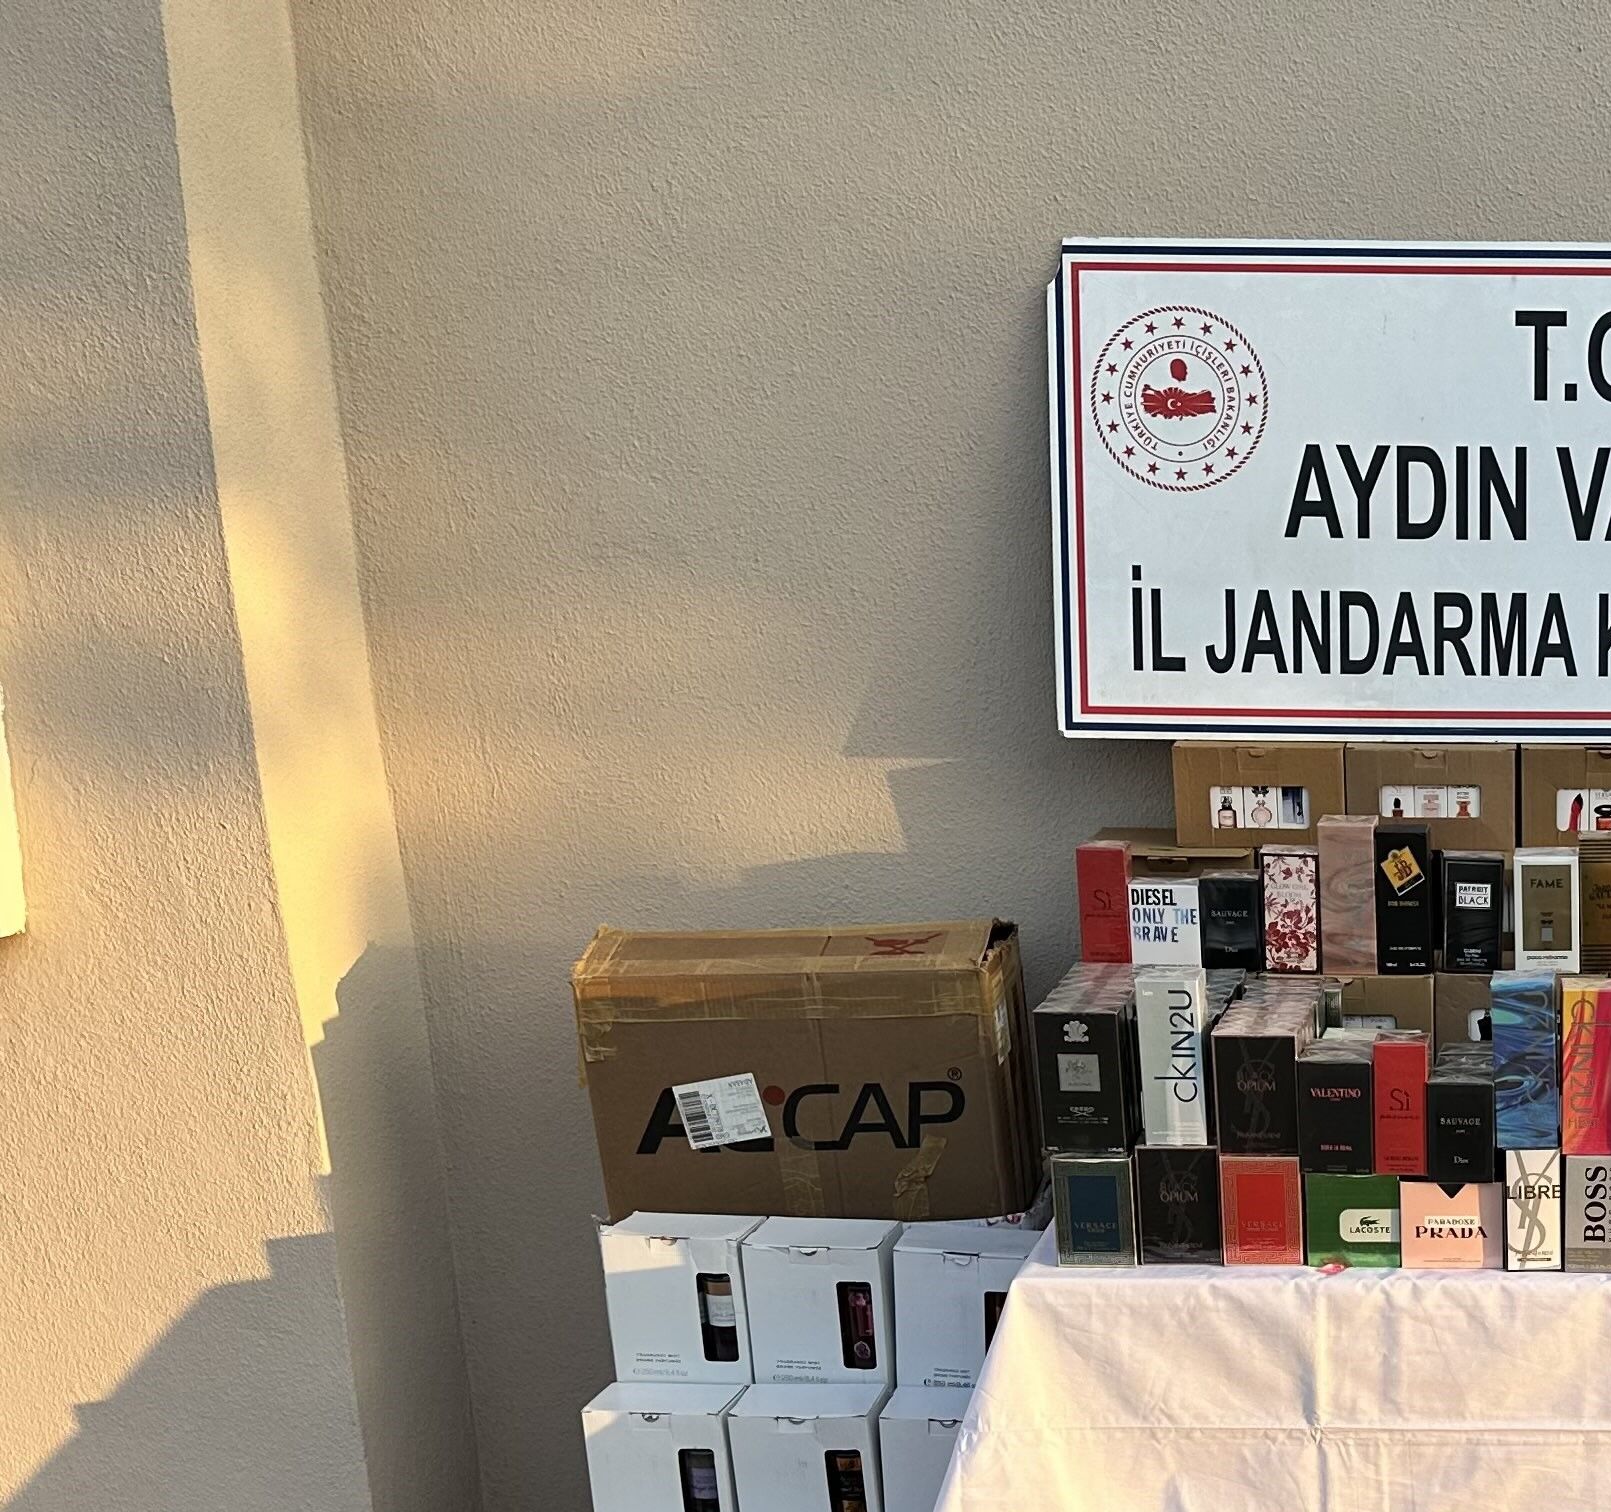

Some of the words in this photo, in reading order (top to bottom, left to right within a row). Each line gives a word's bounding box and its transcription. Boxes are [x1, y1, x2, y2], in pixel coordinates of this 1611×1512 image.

[1285, 444, 1528, 541] AYDIN
[1131, 565, 1186, 673] İL
[1206, 591, 1578, 680] JANDARMA
[1530, 878, 1564, 889] FAME
[1131, 888, 1177, 906] DIESEL
[1458, 895, 1490, 906] BLACK
[1132, 908, 1164, 925] ONLY
[1174, 908, 1198, 925] THE
[1210, 910, 1249, 918] SAUVAGE
[1133, 926, 1179, 943] BRAVE
[1236, 1080, 1276, 1092] OPIUM
[1309, 1087, 1362, 1099] VALENTINO
[1439, 1117, 1482, 1127] SAUVAGE
[1159, 1191, 1199, 1202] OPIUM
[1584, 1165, 1608, 1243] BOSS
[1349, 1226, 1391, 1235] LACOSTE
[1415, 1226, 1489, 1240] PRADA
